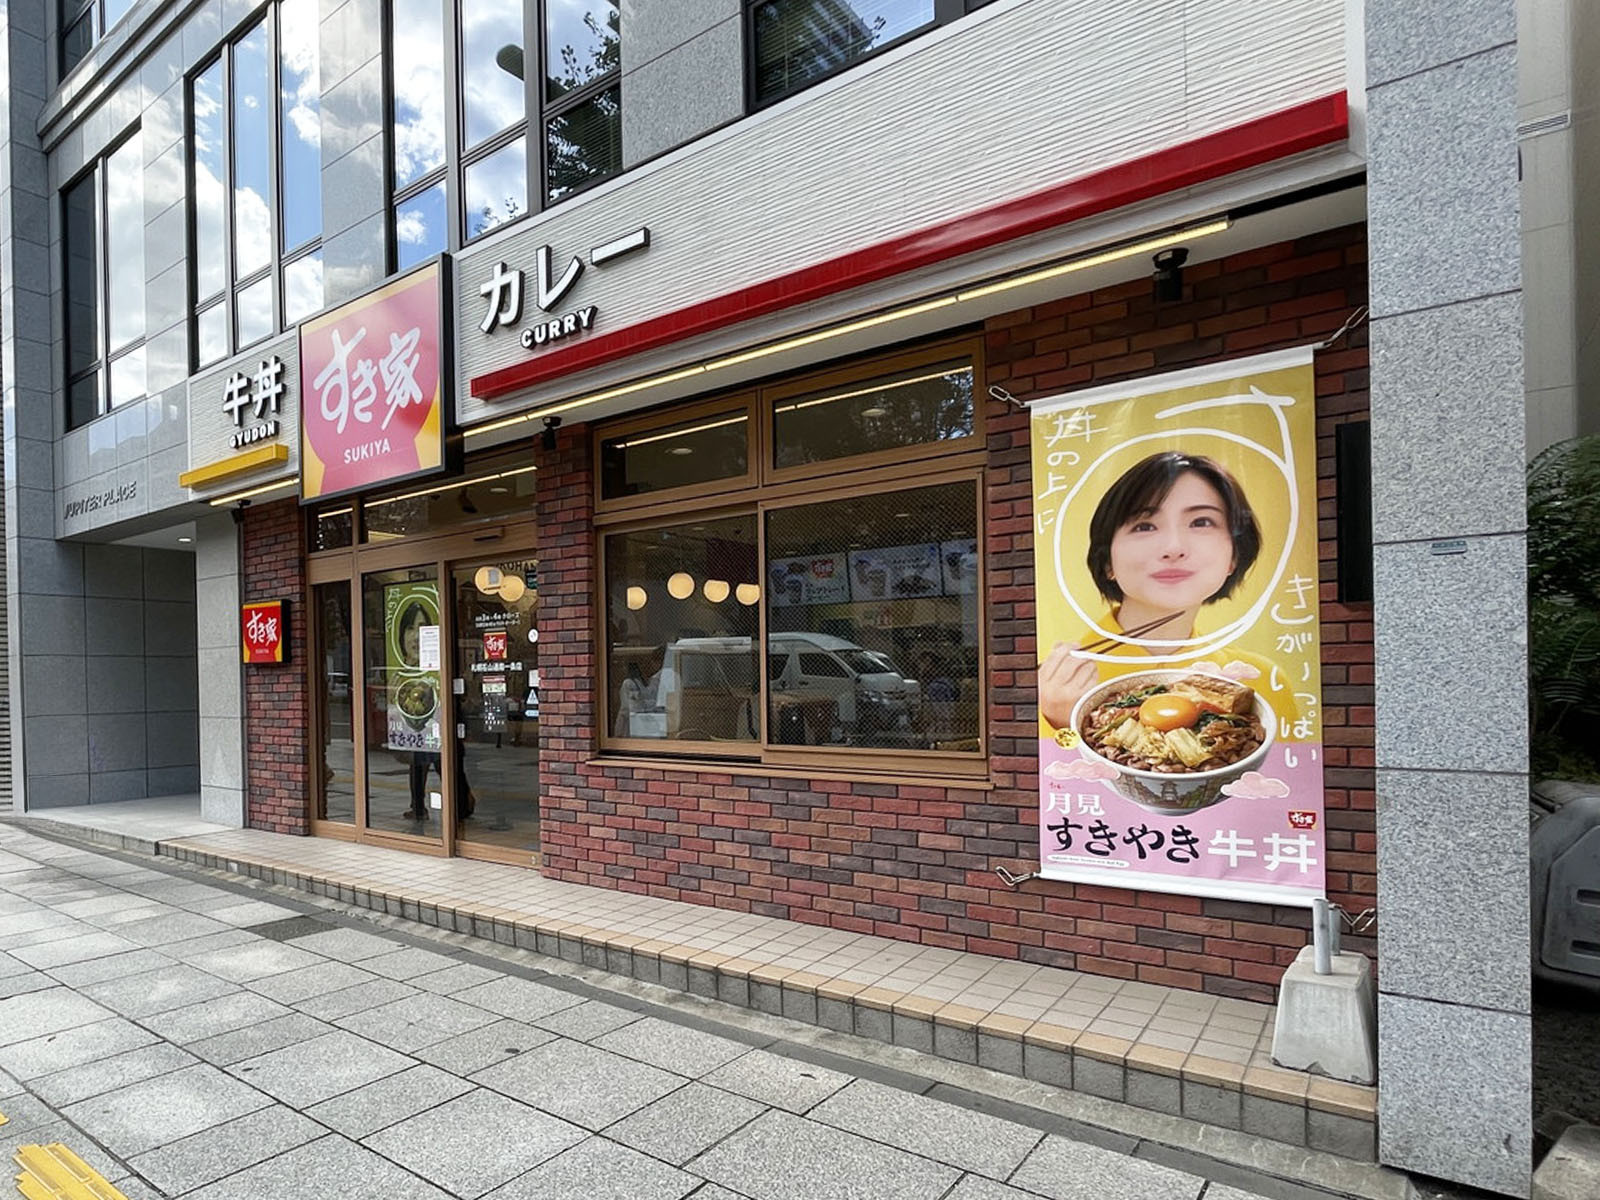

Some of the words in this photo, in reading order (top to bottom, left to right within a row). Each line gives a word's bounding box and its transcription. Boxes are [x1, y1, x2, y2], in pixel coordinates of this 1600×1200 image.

[480, 227, 651, 334] カレー
[520, 305, 598, 349] CURRY
[222, 355, 286, 427] 牛丼
[313, 326, 423, 434] すき家
[229, 420, 280, 449] GYUDON
[344, 438, 391, 464] SUKIYA
[64, 494, 103, 520] JUPITER
[103, 480, 138, 507] PLACE
[246, 609, 278, 647] すき家
[1046, 791, 1105, 817] 月見
[1047, 816, 1200, 864] すきやき
[1208, 829, 1318, 874] 牛丼
